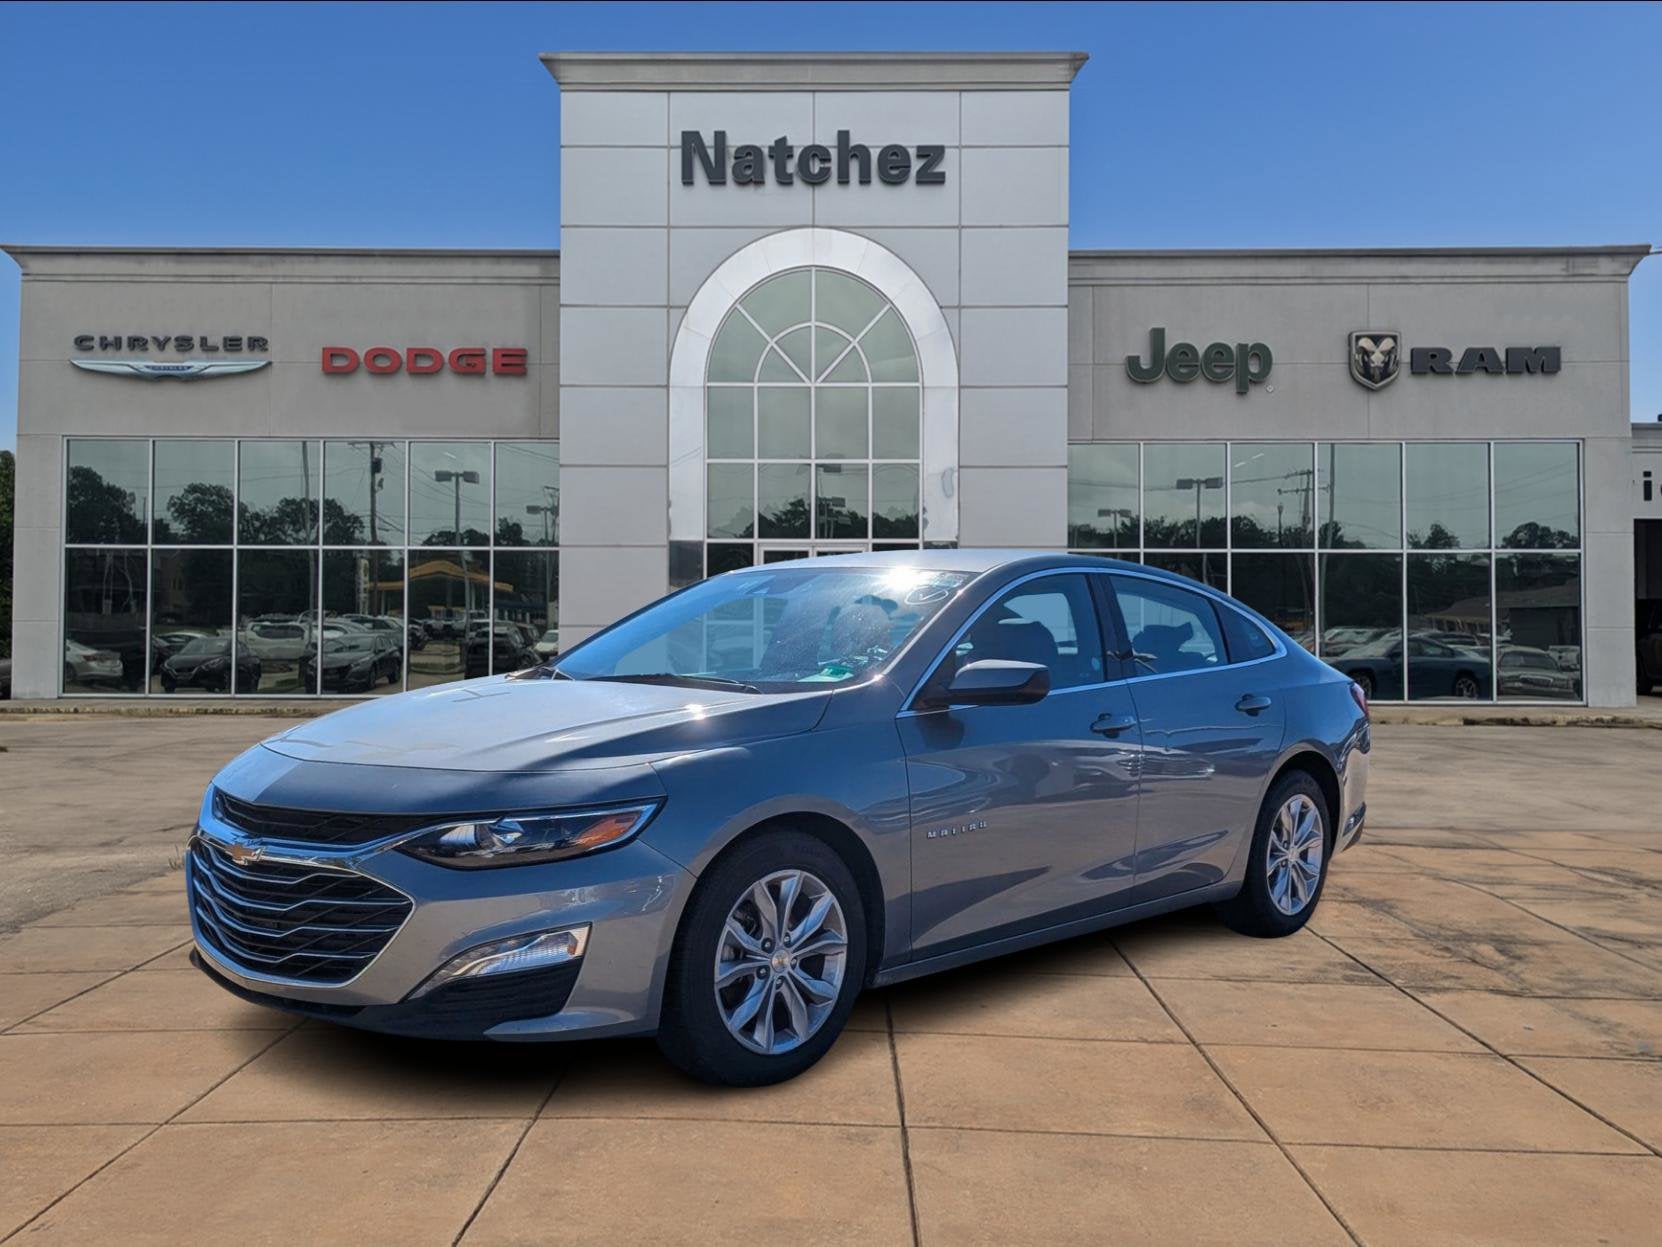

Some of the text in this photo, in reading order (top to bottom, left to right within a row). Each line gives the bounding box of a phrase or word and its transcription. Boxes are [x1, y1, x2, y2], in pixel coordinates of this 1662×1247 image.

[681, 129, 946, 186] Natchez
[73, 335, 269, 351] CHRYSLER
[321, 346, 528, 376] DODGE
[1126, 327, 1273, 394] Jeep
[1410, 346, 1561, 375] RAM
